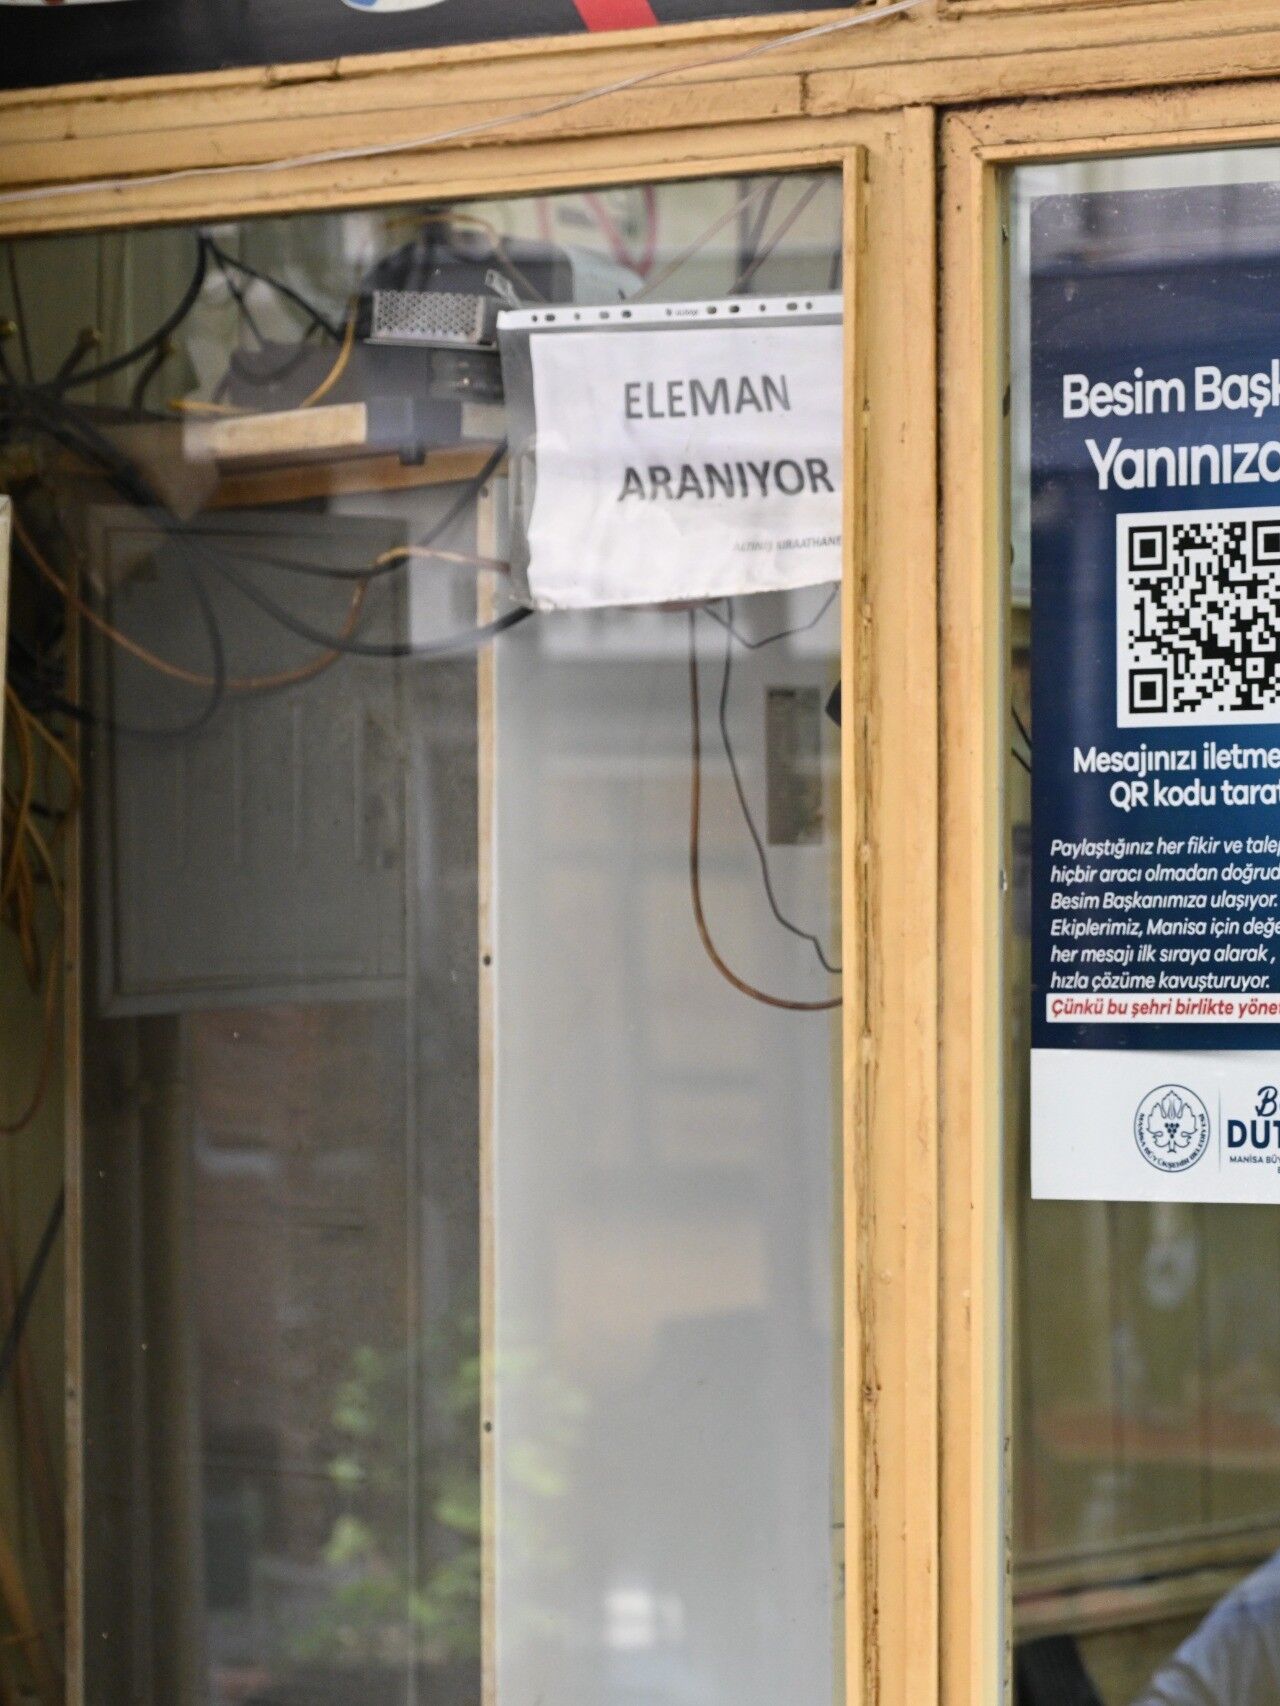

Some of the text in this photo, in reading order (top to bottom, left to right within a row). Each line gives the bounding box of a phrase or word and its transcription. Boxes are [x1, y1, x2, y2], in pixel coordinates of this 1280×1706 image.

[624, 375, 791, 419] ELEMAN
[1063, 367, 1186, 418] Besim
[617, 458, 834, 501] ARANIYOR
[1073, 743, 1197, 778] Mesajınızı
[1109, 780, 1149, 813] QR
[1153, 778, 1216, 807] kodu
[1050, 838, 1152, 859] Paylaştığınız
[1157, 837, 1184, 855] her
[1187, 837, 1221, 854] fikir
[1223, 840, 1243, 854] ve
[1050, 865, 1097, 886] hiçbir
[1100, 869, 1142, 882] aracı
[1145, 863, 1217, 882] olmadan
[1050, 890, 1278, 912] Besim Başkanımıza ulaşıyor.
[1050, 918, 1143, 939] Ekiplerimiz,
[1146, 918, 1207, 936] Manisa
[1210, 918, 1241, 938] için
[1050, 945, 1078, 963] her
[1080, 944, 1134, 965] mesajı
[1137, 944, 1157, 963] ilk
[1159, 948, 1211, 965] sıraya
[1050, 971, 1270, 992] hızla çözüme kavuşturuyor.
[1052, 998, 1102, 1017] Çünkü
[1107, 998, 1126, 1015] bu
[1131, 998, 1172, 1017] şehri
[1175, 998, 1234, 1015] birlikte
[1229, 1155, 1263, 1164] MANİSA
